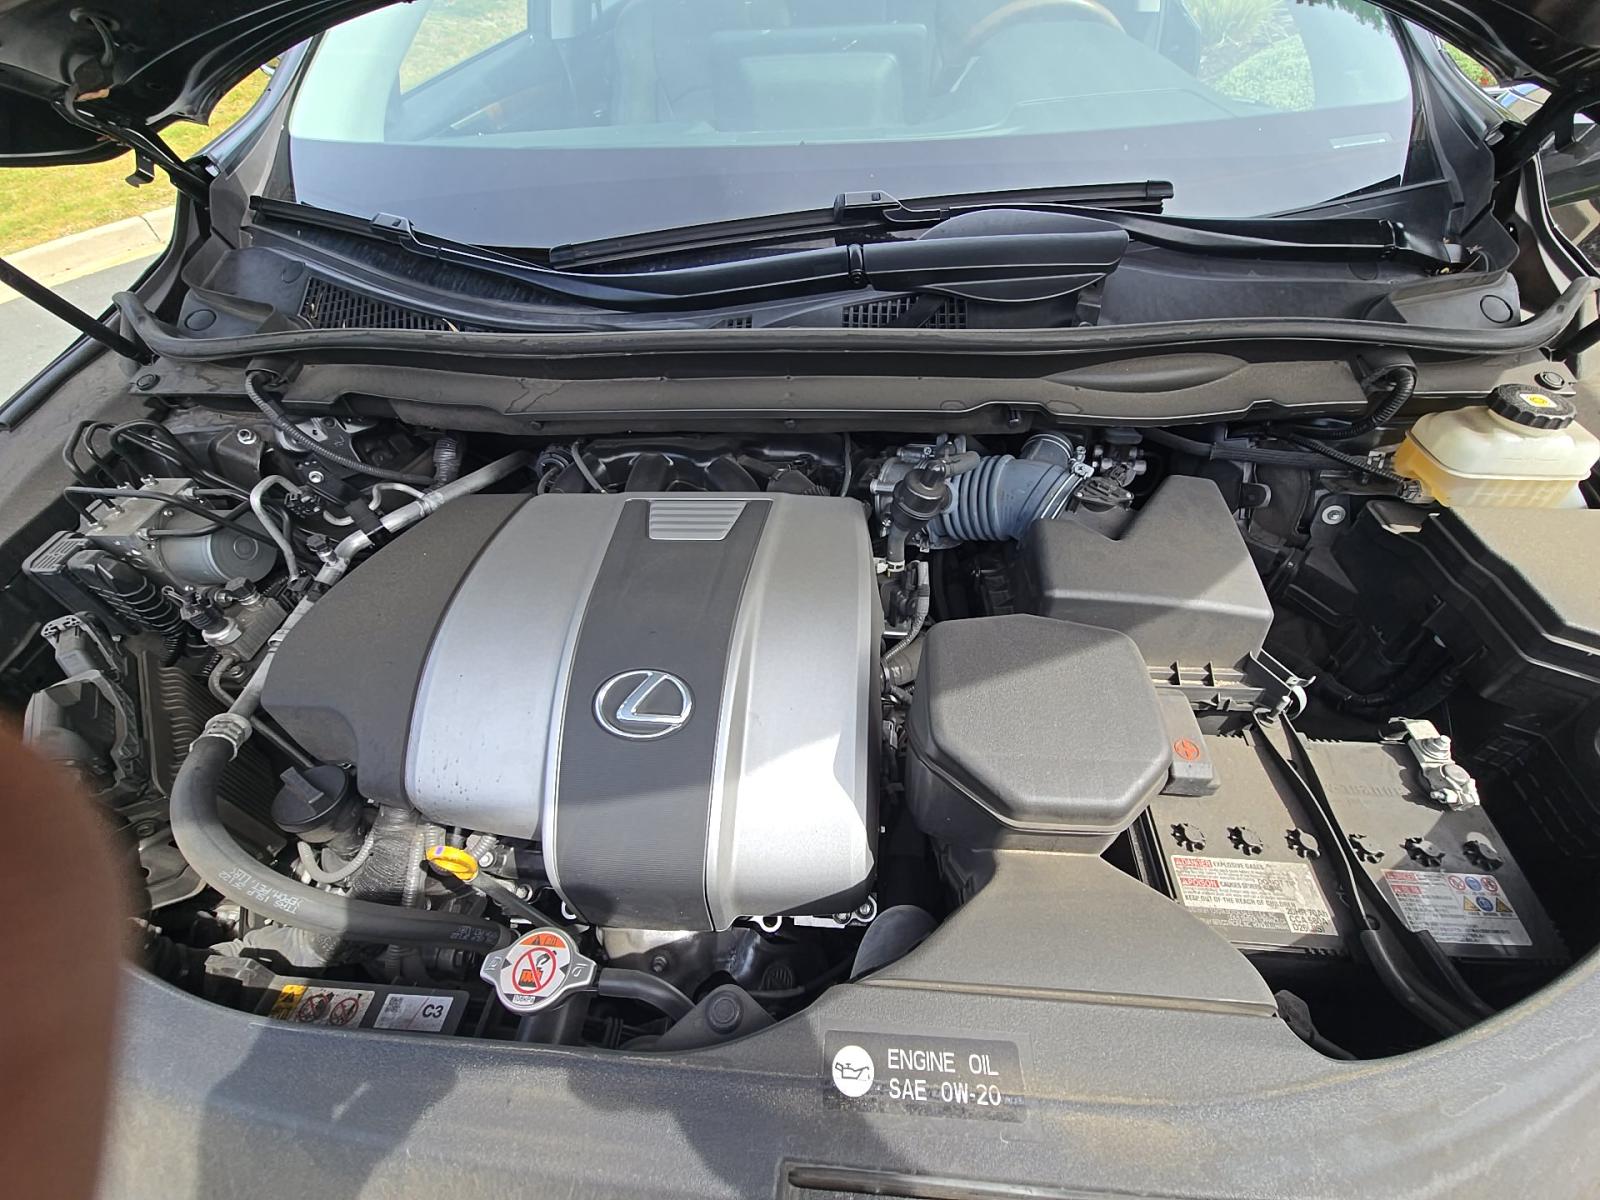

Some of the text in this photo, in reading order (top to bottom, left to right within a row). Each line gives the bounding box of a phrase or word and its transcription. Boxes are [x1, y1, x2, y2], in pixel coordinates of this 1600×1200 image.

[422, 1003, 444, 1018] C3
[888, 1048, 1000, 1076] ENGINE OIL
[889, 1078, 928, 1101] SAE
[941, 1081, 1002, 1106] 0W-20
